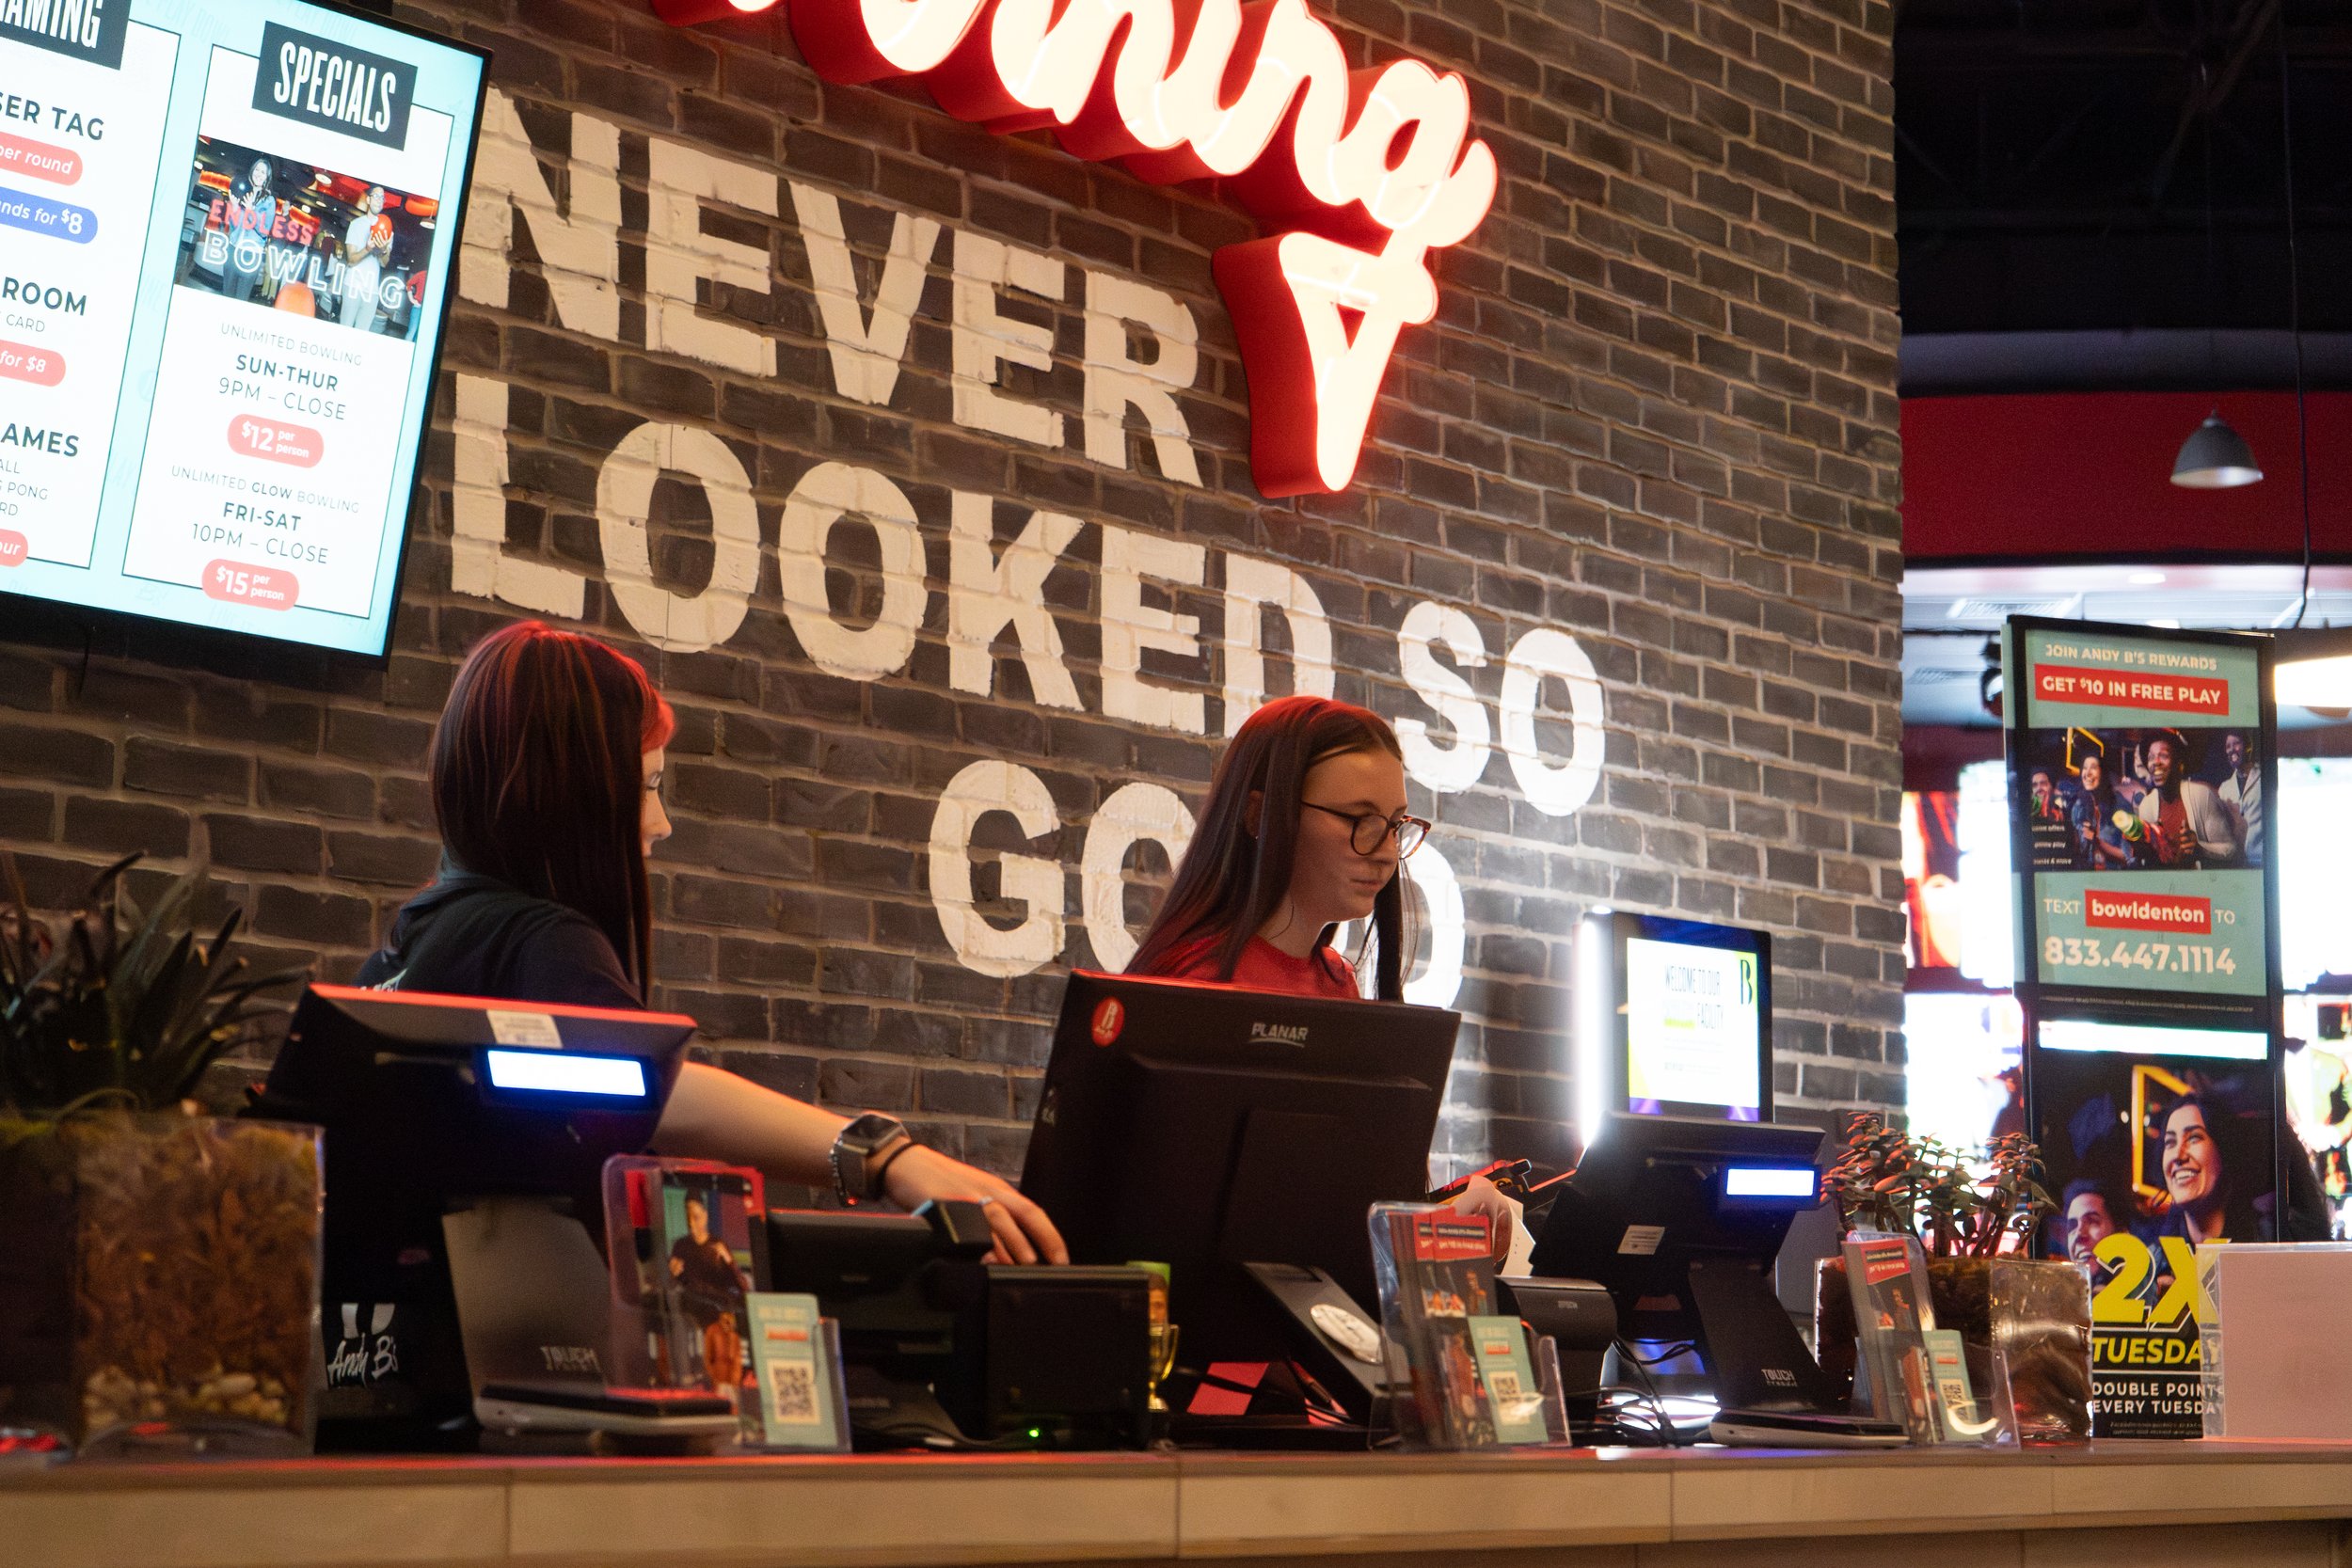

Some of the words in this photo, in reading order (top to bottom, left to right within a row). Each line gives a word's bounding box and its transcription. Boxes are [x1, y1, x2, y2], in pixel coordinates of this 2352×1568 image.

[0, 0, 103, 48] AMING
[274, 41, 397, 133] SPECIALS
[52, 106, 103, 141] TAG
[24, 150, 73, 175] round
[0, 198, 30, 219] nds
[34, 208, 57, 226] for
[61, 208, 84, 235] $8
[208, 198, 314, 245] ENDLESS
[201, 229, 405, 309] BOWLING
[456, 85, 1204, 489] NEVER
[2, 277, 87, 316] ROOM
[6, 314, 46, 332] CARD
[220, 323, 295, 351] UNLIMITED
[299, 341, 363, 367] BOWLING
[25, 355, 46, 372] $8
[235, 354, 339, 391] SUN-THUR
[218, 376, 262, 402] 9PM
[284, 391, 346, 420] CLOSE
[241, 420, 274, 451] $12
[277, 430, 295, 443] per
[275, 442, 310, 459] person
[8, 481, 48, 500] PONG
[171, 465, 246, 490] UNLIMITED
[251, 482, 293, 499] GLOW
[296, 490, 360, 514] BOWLING
[223, 501, 302, 531] FRI-SAT
[193, 523, 243, 547] 10PM
[265, 538, 329, 564] CLOSE
[215, 564, 249, 596] $15
[252, 573, 271, 585] per
[249, 587, 285, 601] person
[452, 372, 1336, 739] LOOKED
[1394, 600, 1605, 816] SO
[2045, 644, 2077, 659] JOIN
[2081, 647, 2120, 662] ANDY
[2123, 650, 2145, 665] B'S
[2149, 653, 2217, 672] REWARDS
[2042, 675, 2075, 693] GET
[2080, 676, 2104, 695] $10
[2108, 680, 2126, 697] IN
[2131, 682, 2173, 701] FREE
[2178, 687, 2221, 705] PLAY
[2043, 897, 2081, 914] TEXT
[2091, 898, 2204, 924] bowldenton
[2214, 908, 2236, 925] TO
[2044, 935, 2236, 975] 833.447.1114
[1250, 1022, 1309, 1041] PLANAR
[2091, 1232, 2232, 1326] 2X
[326, 1332, 369, 1388] Andy
[2092, 1382, 2159, 1397] DOUBLE
[2092, 1399, 2145, 1415] EVERY
[2151, 1400, 2220, 1415] TUESDA
